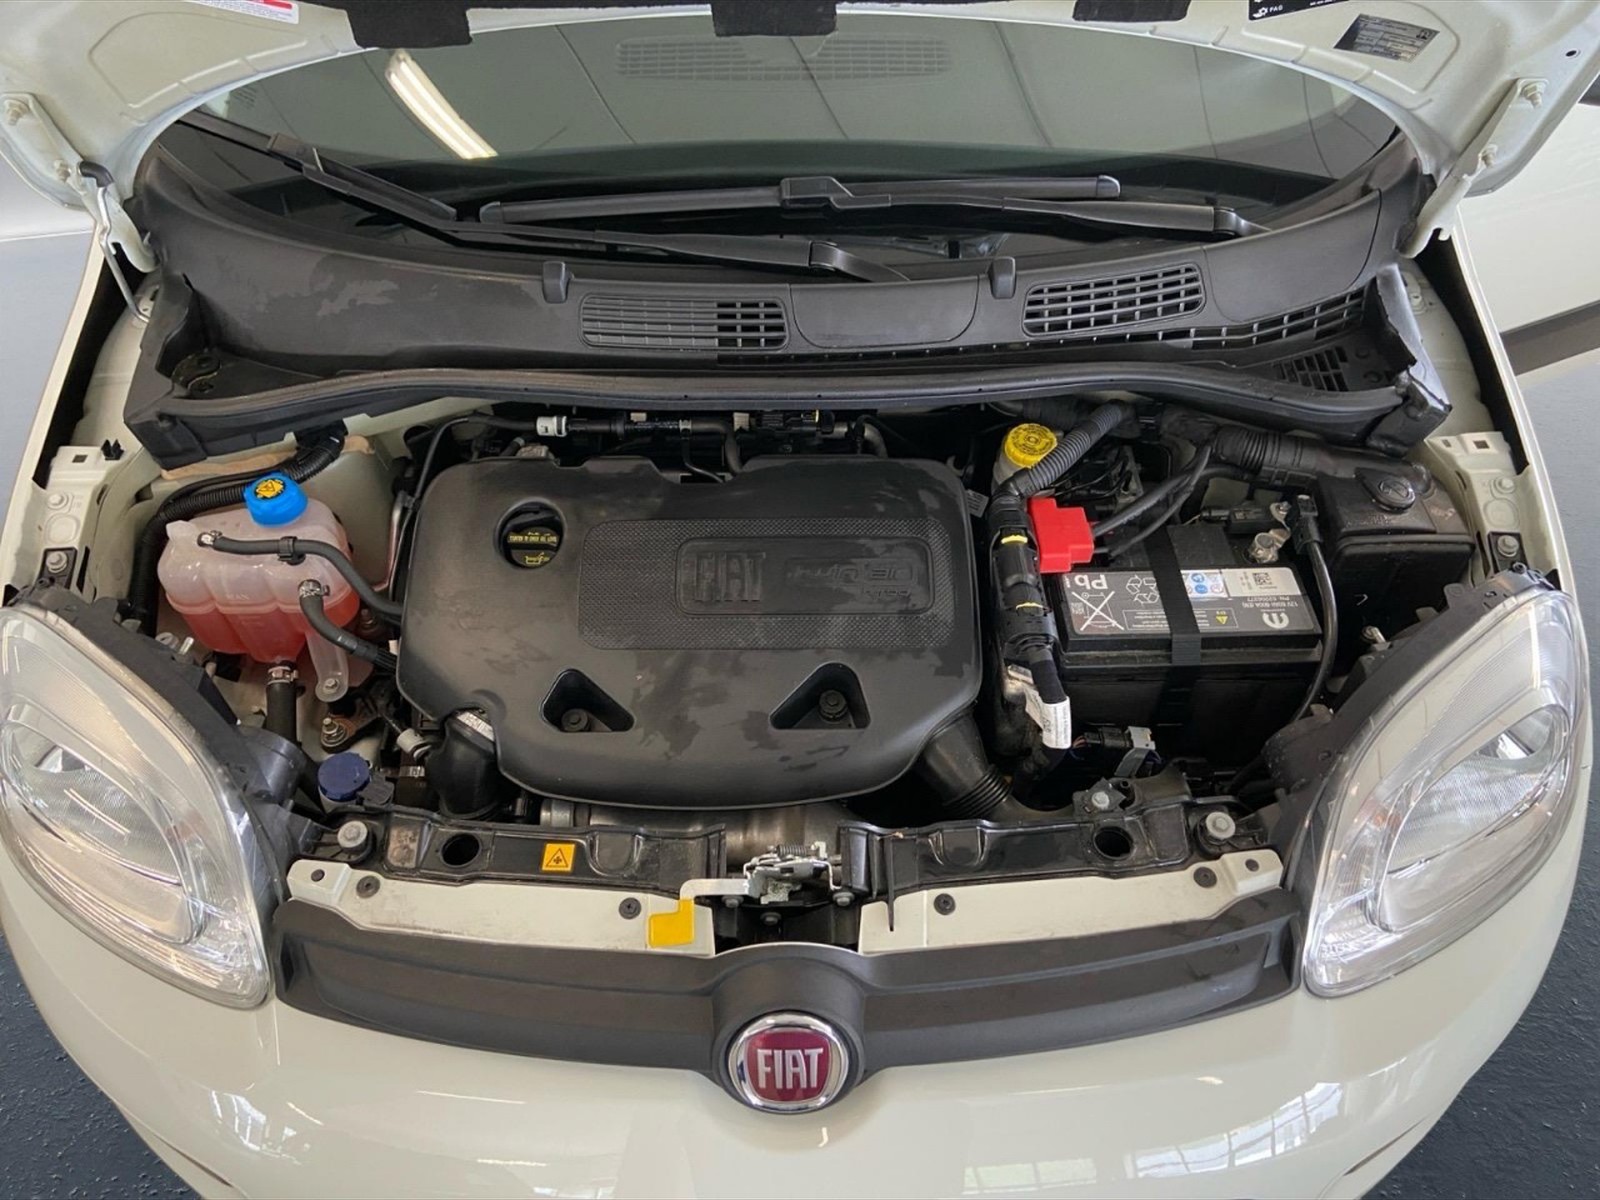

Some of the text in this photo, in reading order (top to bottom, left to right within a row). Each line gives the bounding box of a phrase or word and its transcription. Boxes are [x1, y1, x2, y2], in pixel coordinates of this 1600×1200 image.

[693, 551, 767, 602] FIAT
[1074, 574, 1108, 590] Pb
[756, 1047, 824, 1090] FIAT
